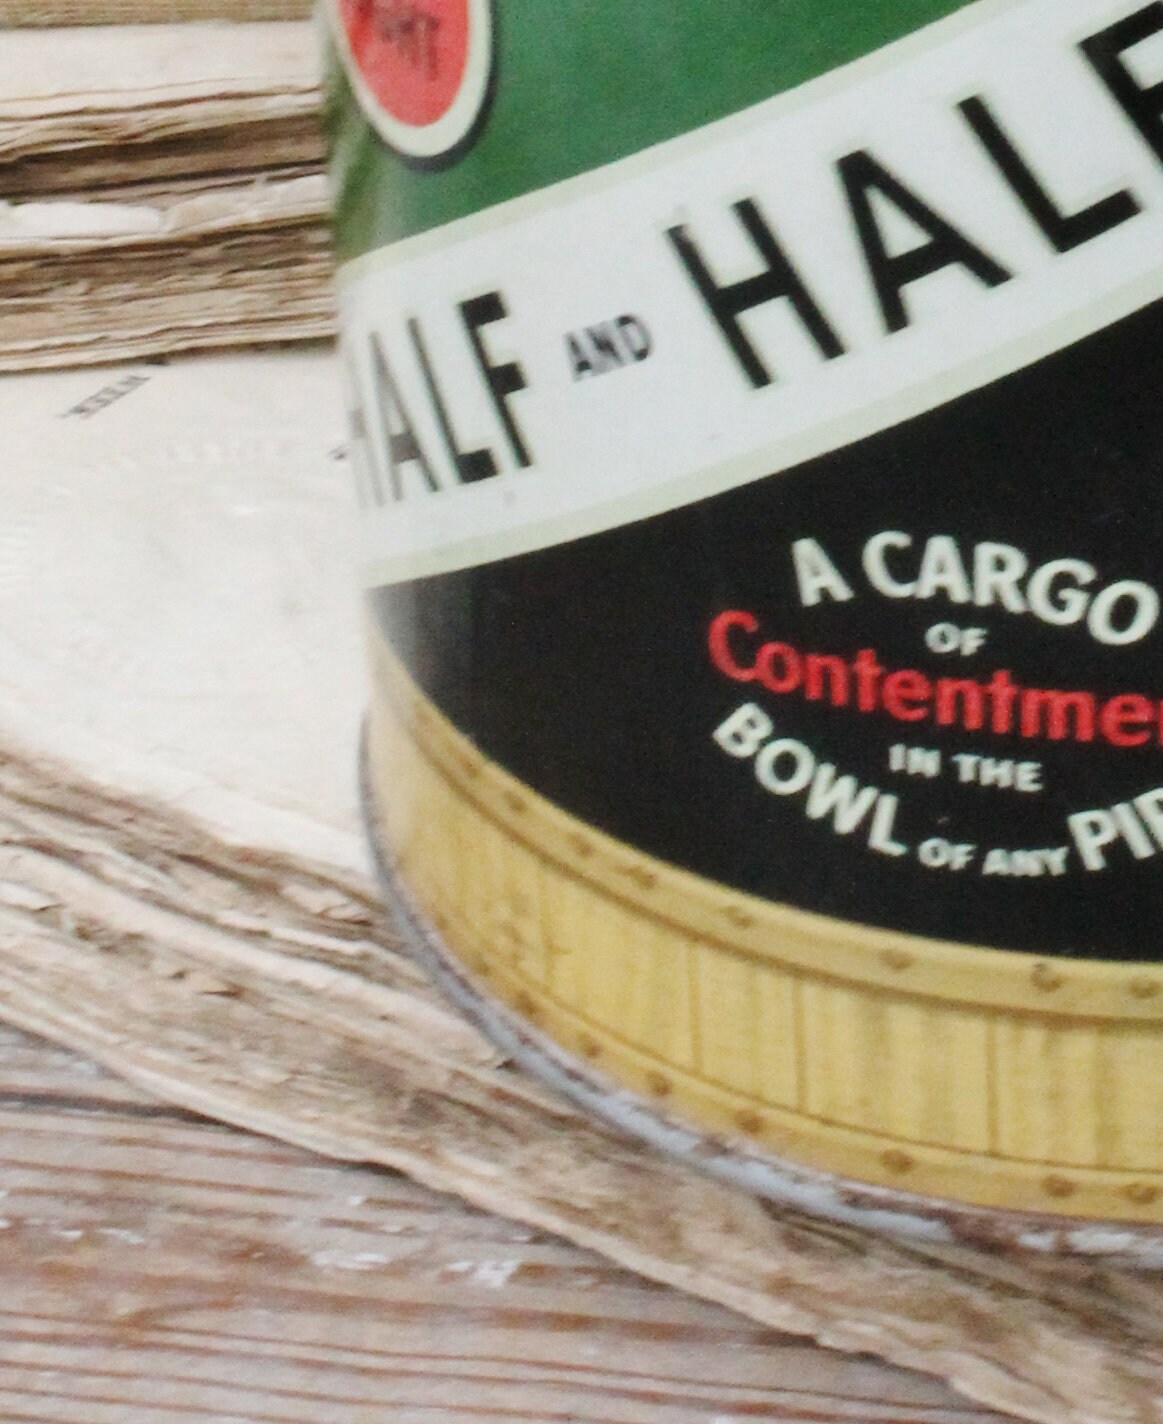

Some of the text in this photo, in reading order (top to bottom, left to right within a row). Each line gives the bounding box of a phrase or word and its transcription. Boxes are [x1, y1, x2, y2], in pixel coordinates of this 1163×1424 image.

[563, 313, 657, 383] AND
[790, 530, 1161, 646] A CARGO
[924, 621, 988, 656] OF
[711, 701, 909, 857] BOWL
[917, 837, 979, 871] OF
[981, 846, 1071, 877] ANY
[888, 743, 1045, 793] IN THE
